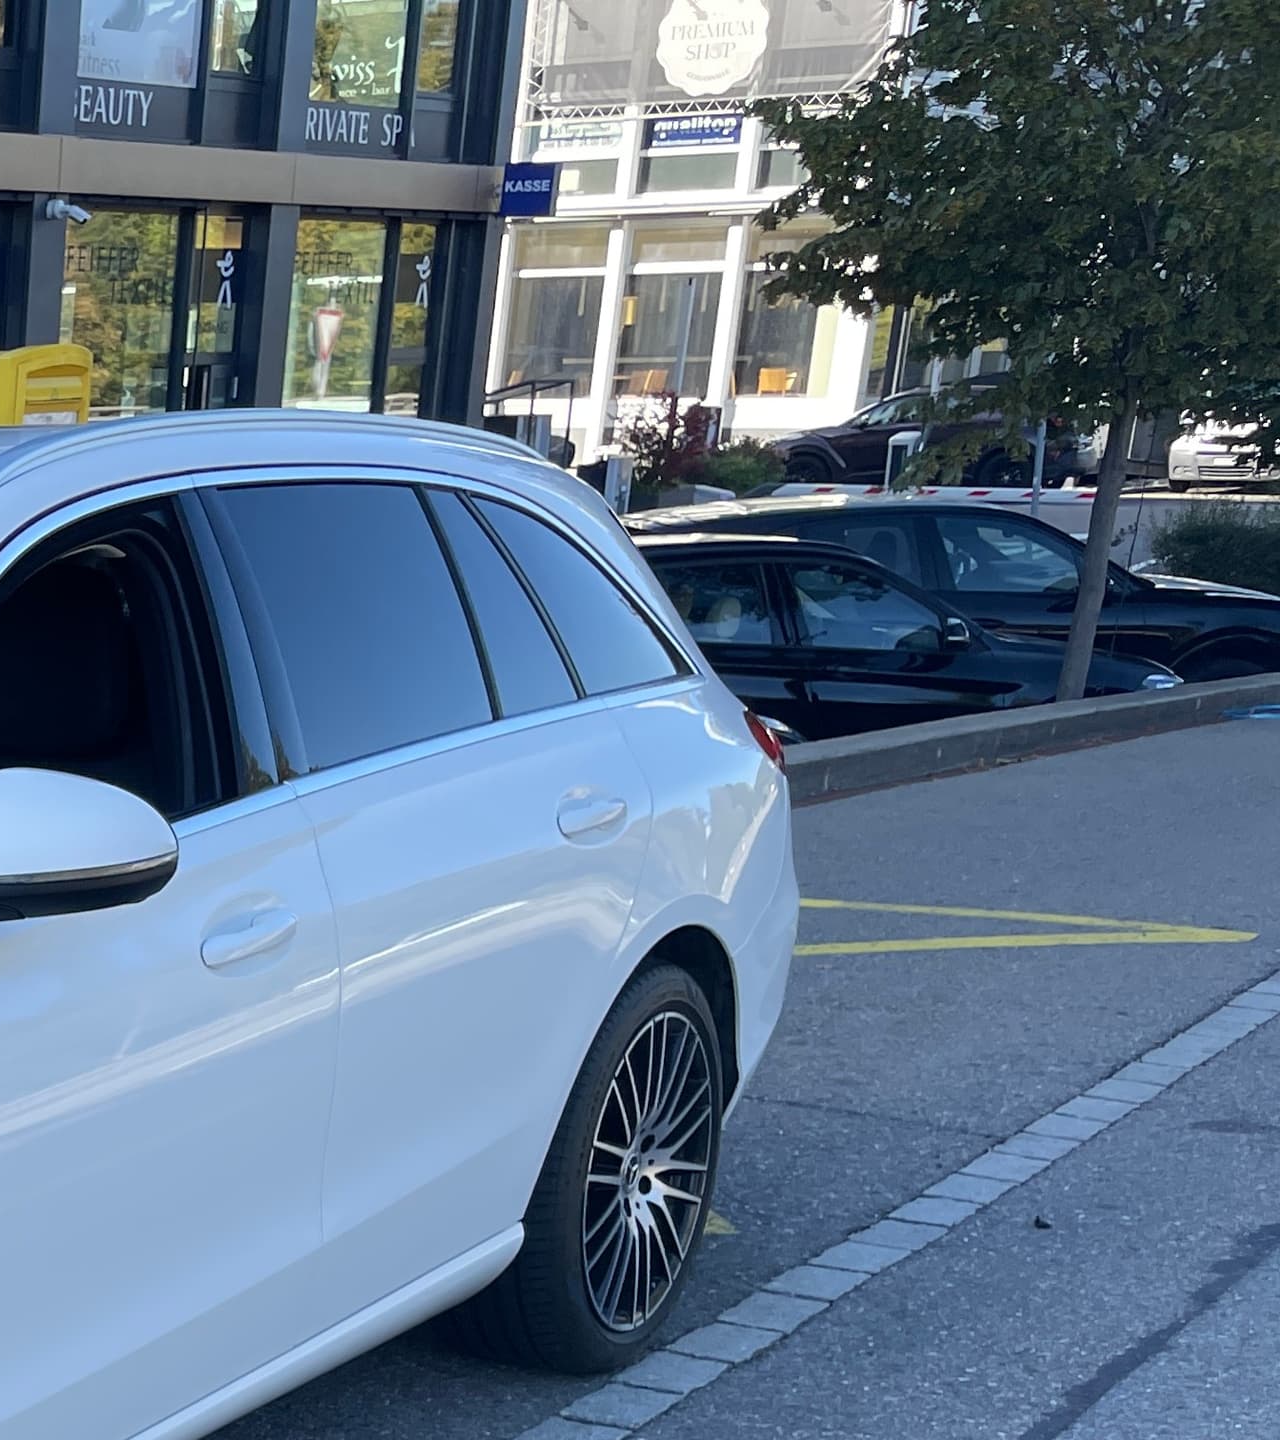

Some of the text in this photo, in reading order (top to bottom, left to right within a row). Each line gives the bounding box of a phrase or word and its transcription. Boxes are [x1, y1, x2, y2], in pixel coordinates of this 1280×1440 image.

[671, 20, 755, 42] PREMIUM
[684, 42, 737, 61] SHOP
[74, 85, 153, 127] EAUTY
[504, 180, 552, 194] KASSE
